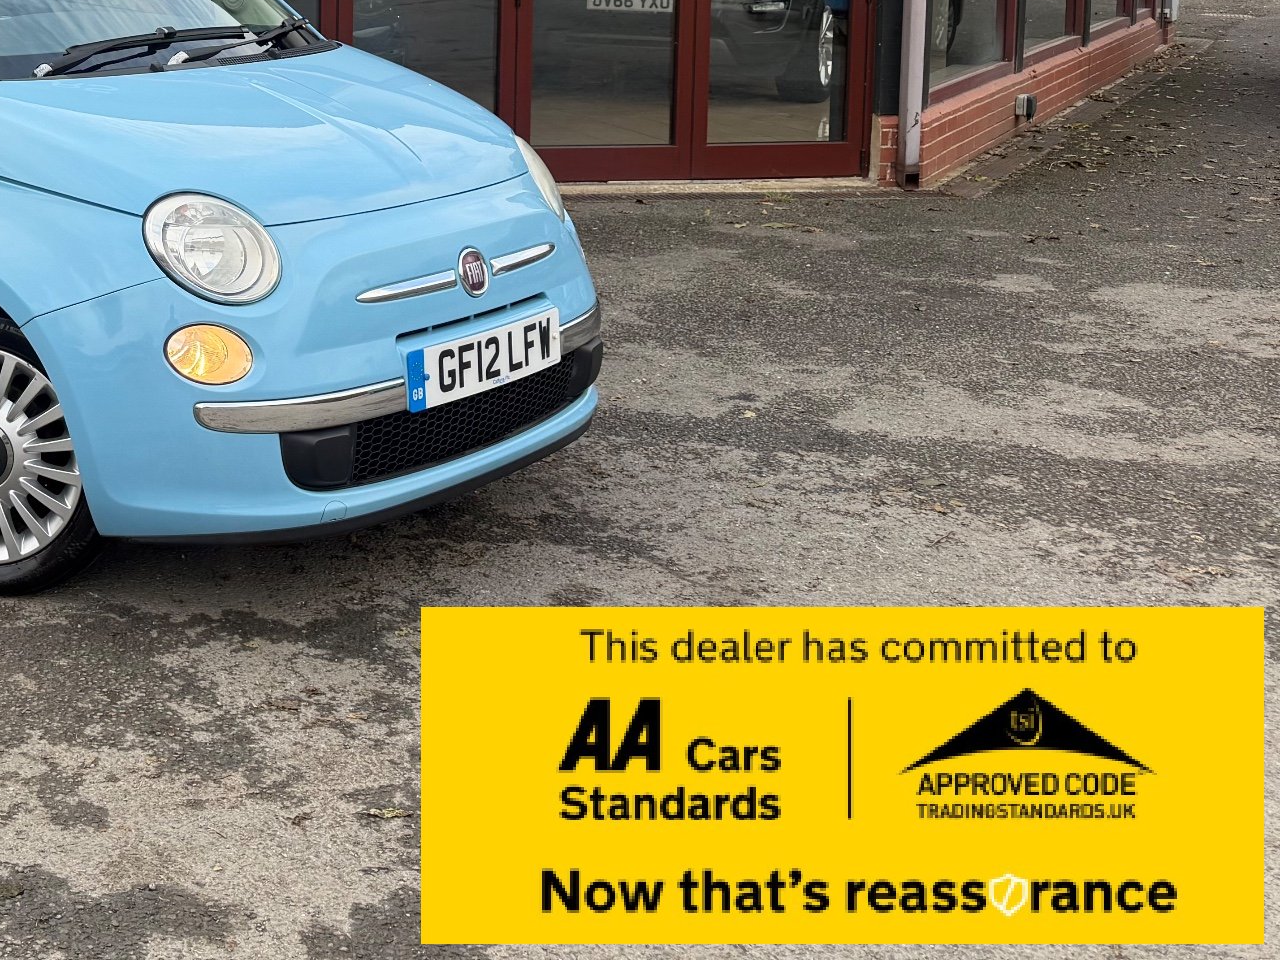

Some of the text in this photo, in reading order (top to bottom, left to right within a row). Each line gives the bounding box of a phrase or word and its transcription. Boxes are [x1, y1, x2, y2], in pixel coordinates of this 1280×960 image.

[465, 261, 484, 284] FIAT
[438, 317, 551, 393] GF12 LFW
[412, 386, 424, 401] GB
